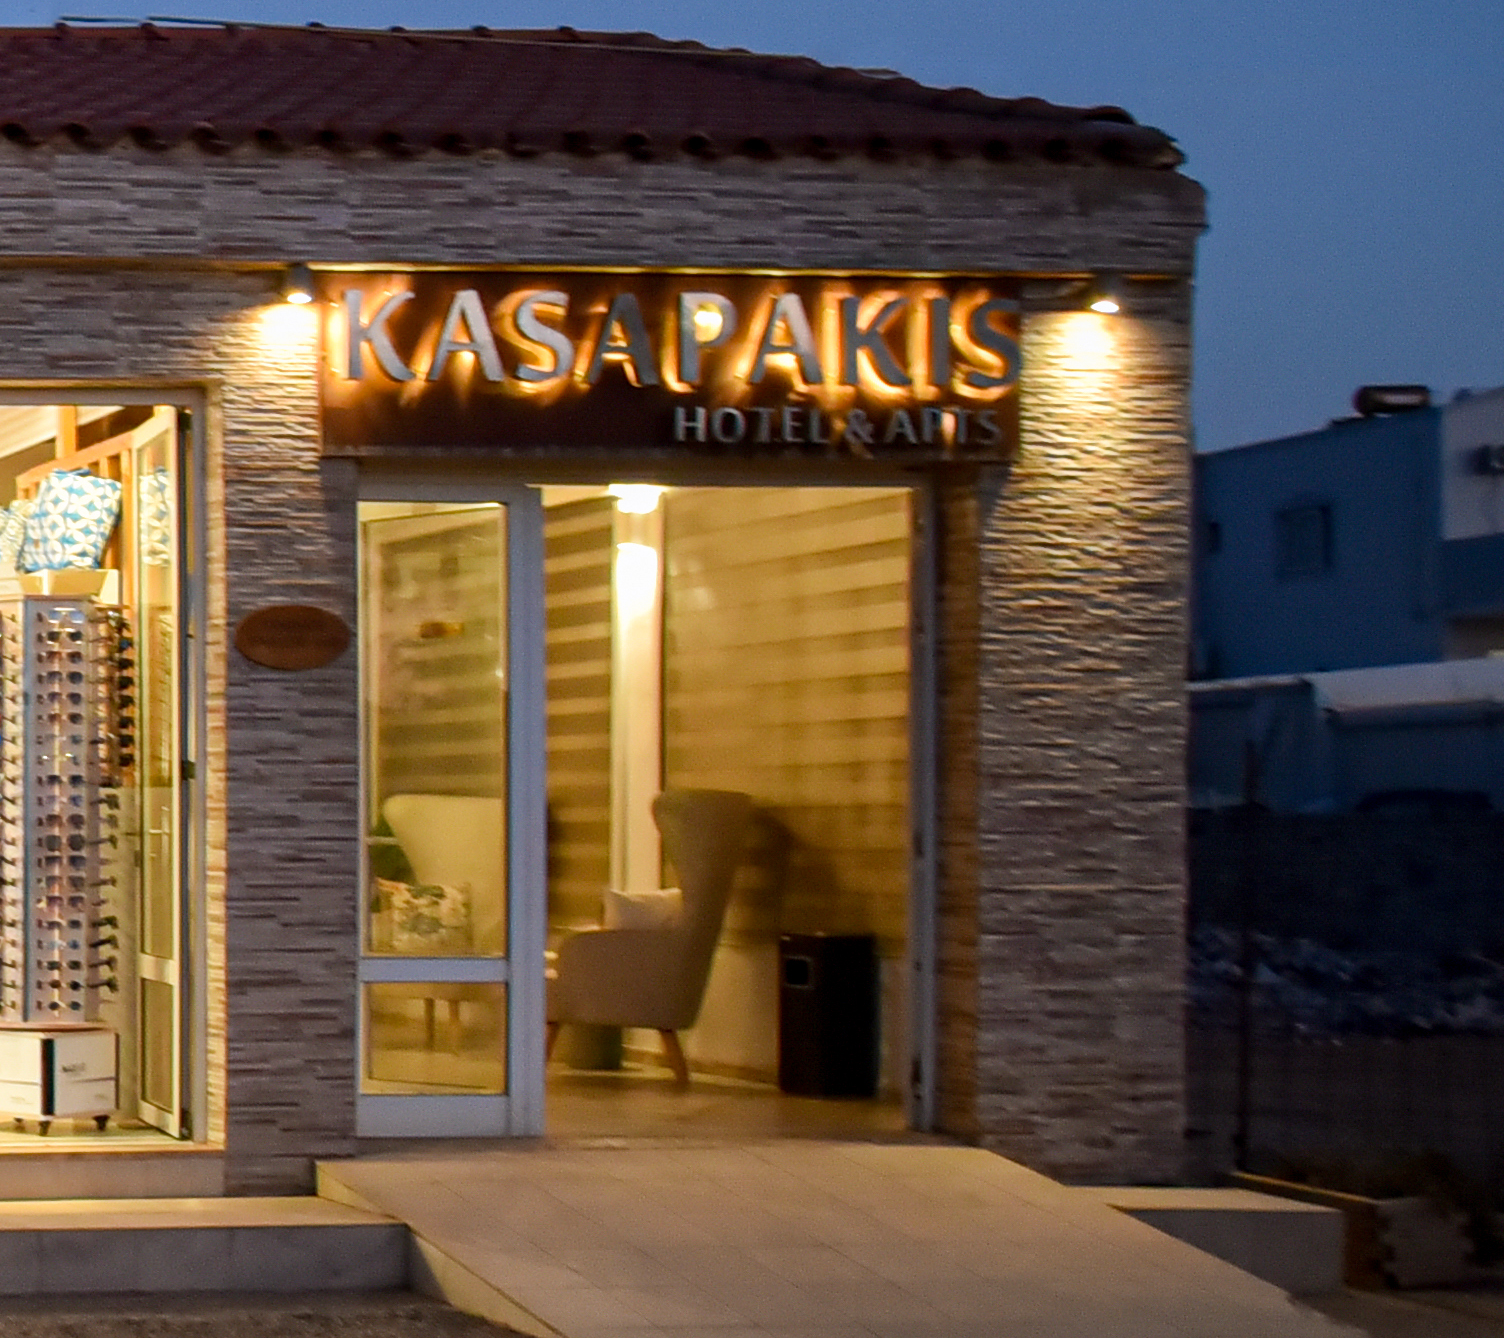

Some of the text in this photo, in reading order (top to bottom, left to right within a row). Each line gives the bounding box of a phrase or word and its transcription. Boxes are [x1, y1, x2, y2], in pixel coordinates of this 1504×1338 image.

[345, 288, 1023, 391] KASAPAKIS
[673, 406, 1003, 445] HOTEL & APTS
